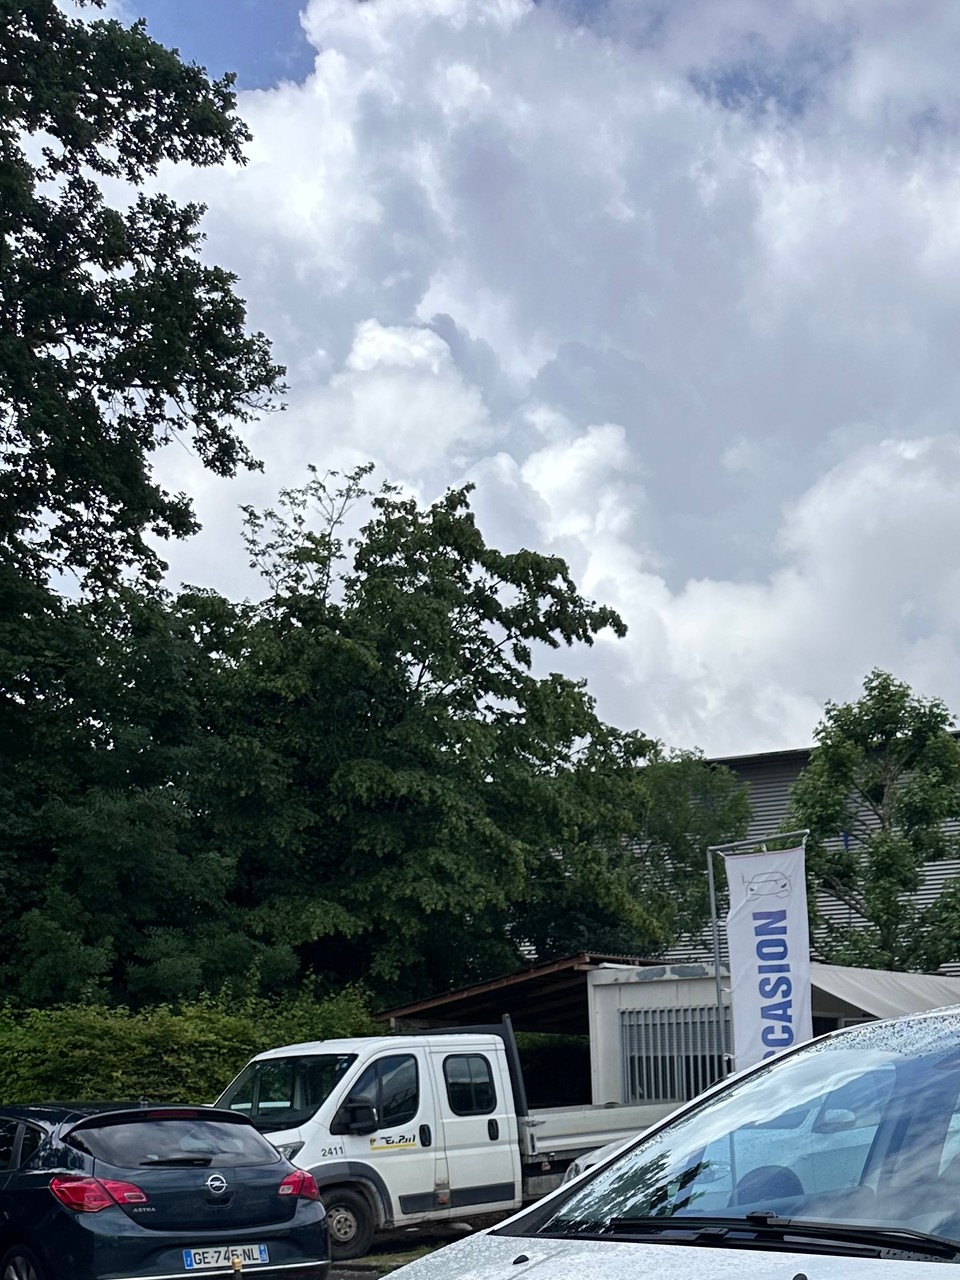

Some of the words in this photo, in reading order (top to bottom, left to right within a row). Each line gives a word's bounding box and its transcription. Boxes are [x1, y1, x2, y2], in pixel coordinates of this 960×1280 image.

[752, 909, 794, 1060] CASION
[321, 1146, 344, 1157] 2411
[193, 1248, 259, 1265] GE-745-NL
